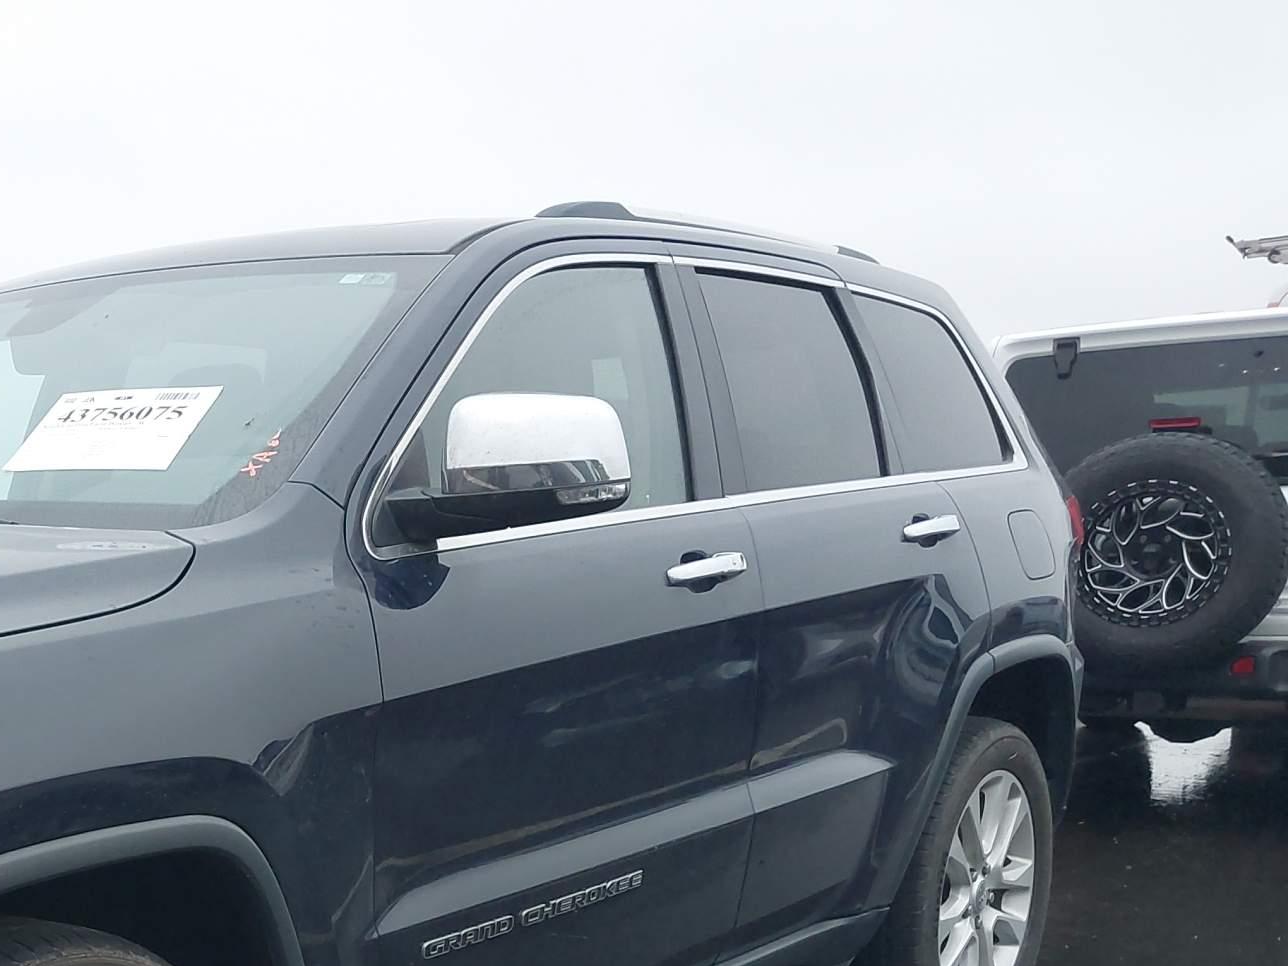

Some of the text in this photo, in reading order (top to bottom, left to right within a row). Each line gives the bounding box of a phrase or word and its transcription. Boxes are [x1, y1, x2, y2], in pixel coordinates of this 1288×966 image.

[57, 405, 189, 423] 43756075
[421, 869, 643, 959] GRAND CHEROKEE
